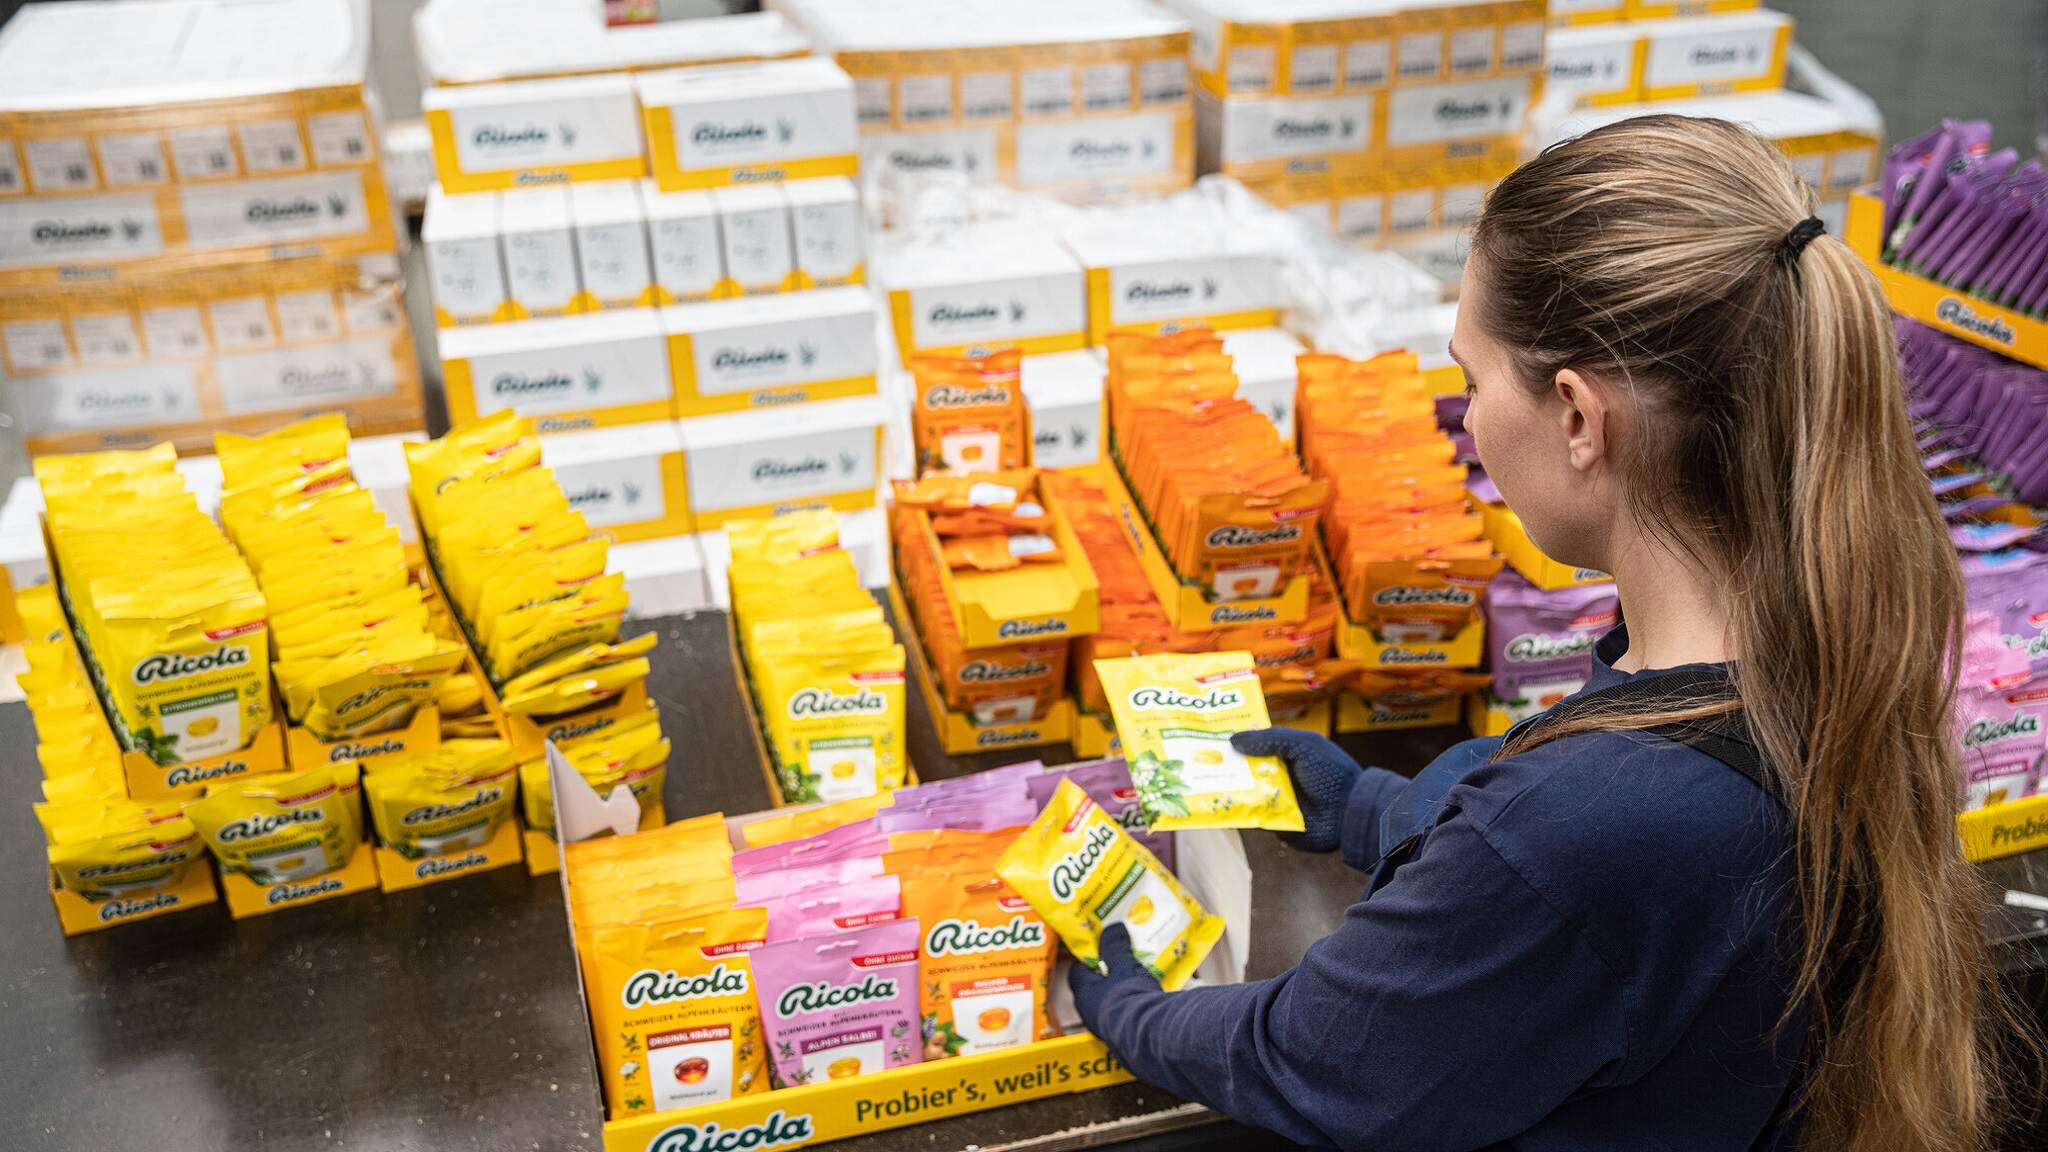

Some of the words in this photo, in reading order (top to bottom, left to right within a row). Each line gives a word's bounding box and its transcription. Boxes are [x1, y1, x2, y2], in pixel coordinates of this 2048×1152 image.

[136, 645, 247, 684] Ricola
[791, 687, 883, 717] Ricola
[1132, 687, 1239, 710] Ricola
[168, 759, 248, 787] Ricola
[218, 808, 324, 842] Ricola
[1053, 824, 1114, 899] Ricola
[929, 918, 1041, 954] Ricola
[625, 964, 746, 1006] Ricola
[778, 975, 897, 1017] Ricola
[651, 1113, 811, 1152] Ricola
